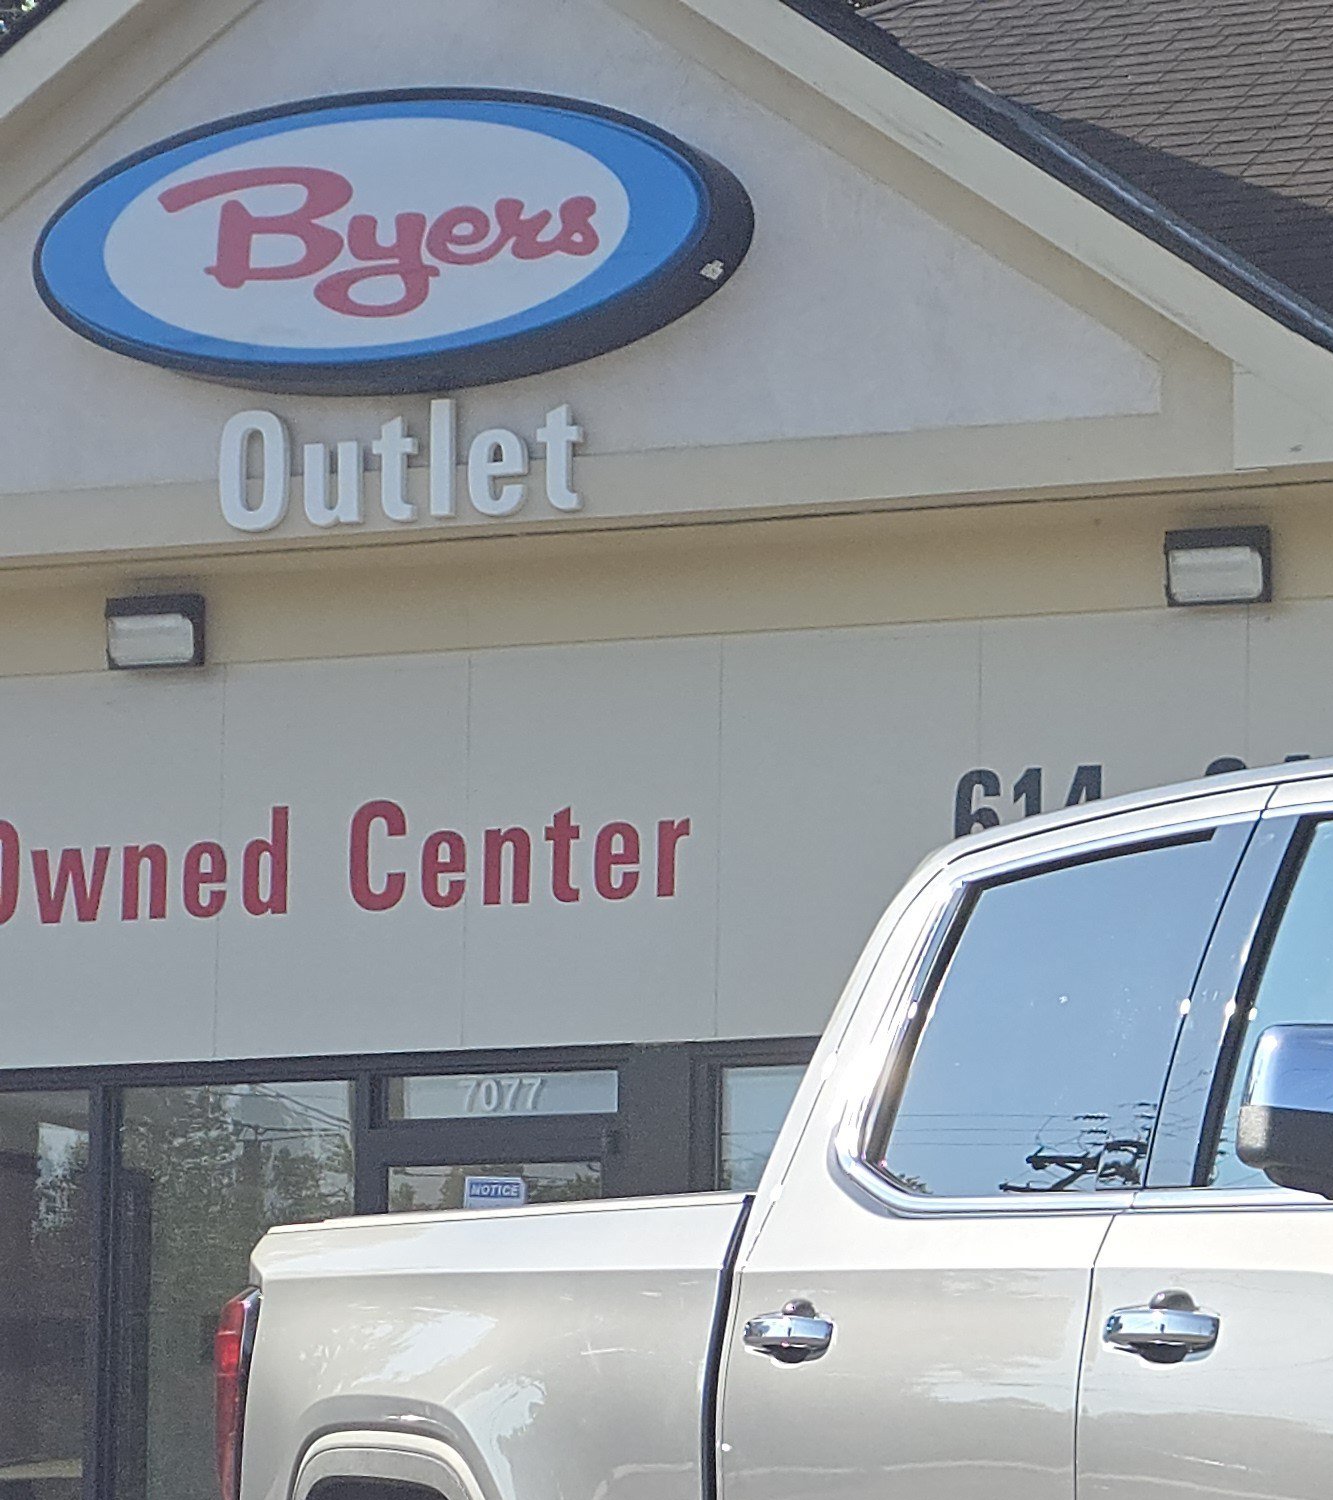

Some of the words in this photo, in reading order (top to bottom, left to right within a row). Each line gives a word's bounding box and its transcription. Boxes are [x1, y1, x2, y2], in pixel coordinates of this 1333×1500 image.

[158, 166, 600, 318] Byers
[218, 399, 584, 532] Outlet
[349, 800, 691, 912] Center
[460, 1078, 543, 1112] 7077
[471, 1184, 520, 1197] NOTICE
